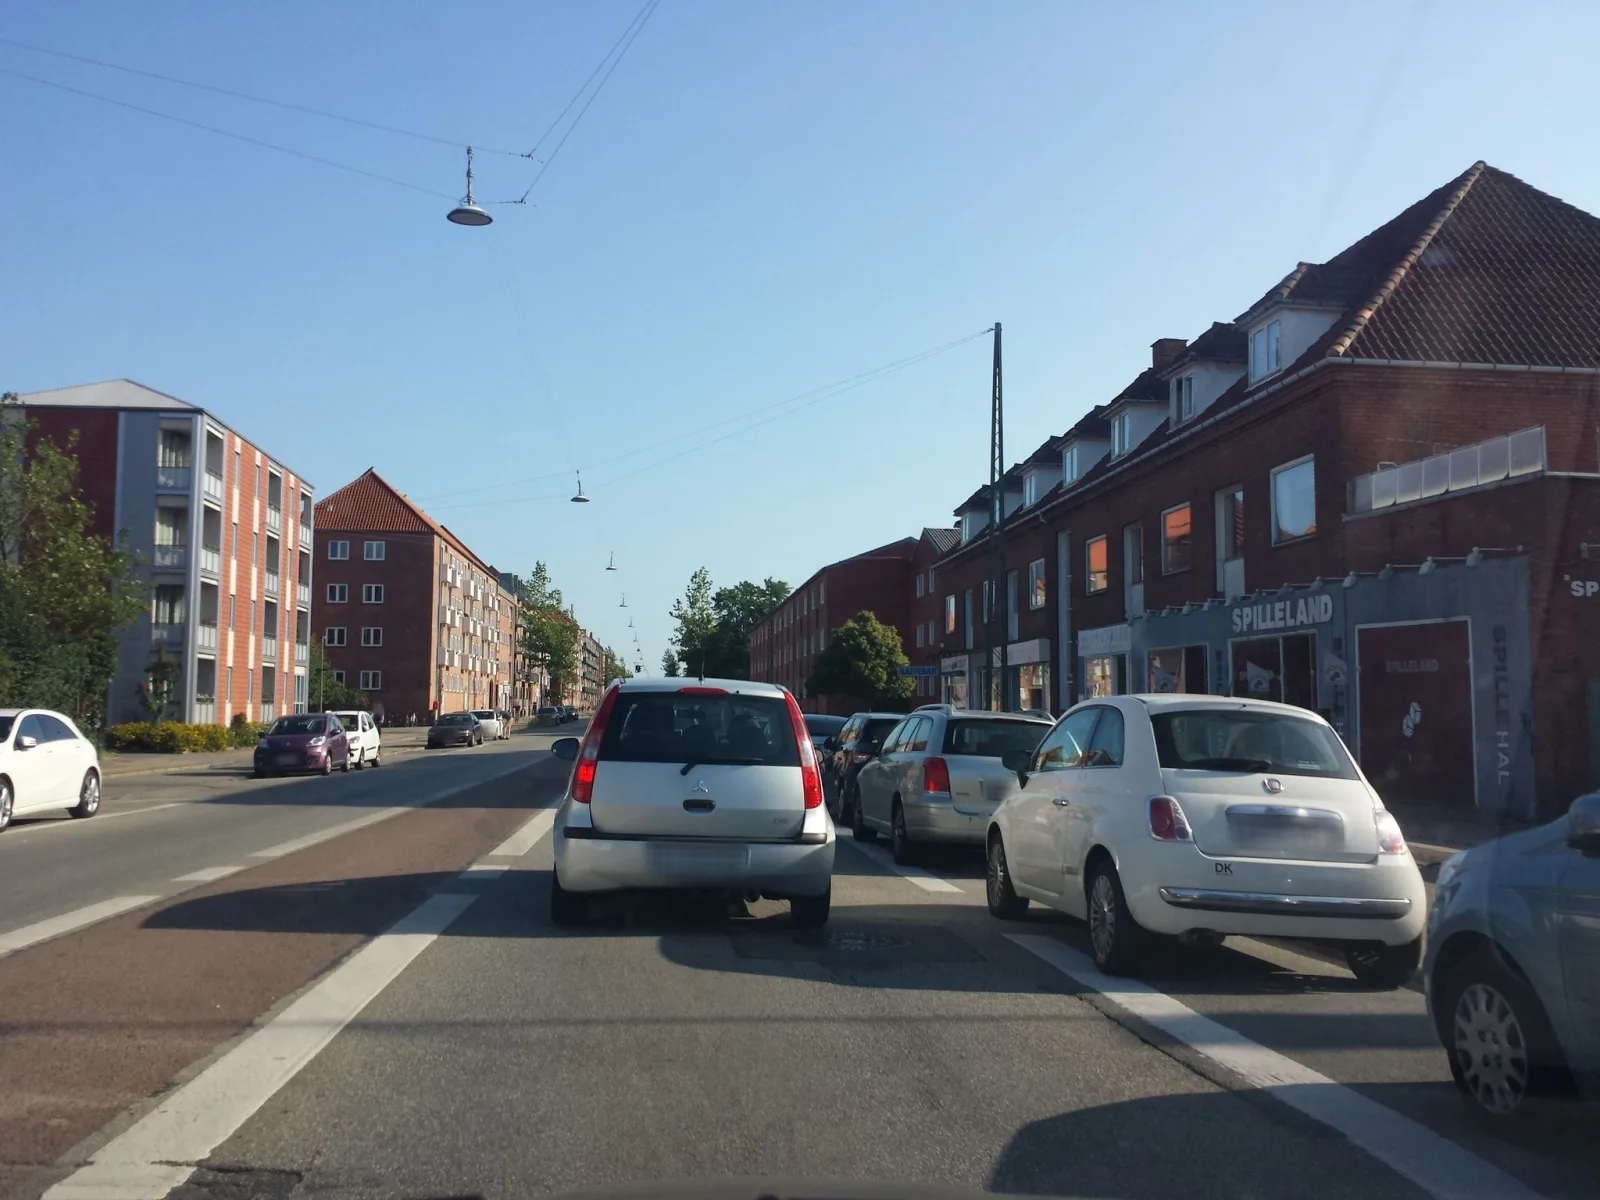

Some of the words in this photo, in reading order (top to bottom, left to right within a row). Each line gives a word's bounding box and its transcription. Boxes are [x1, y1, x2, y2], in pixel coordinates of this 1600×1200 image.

[1232, 595, 1333, 633] SPILLELAND
[1493, 625, 1509, 728] SPILLE
[1496, 731, 1510, 785] HAL
[1215, 862, 1233, 874] DK
